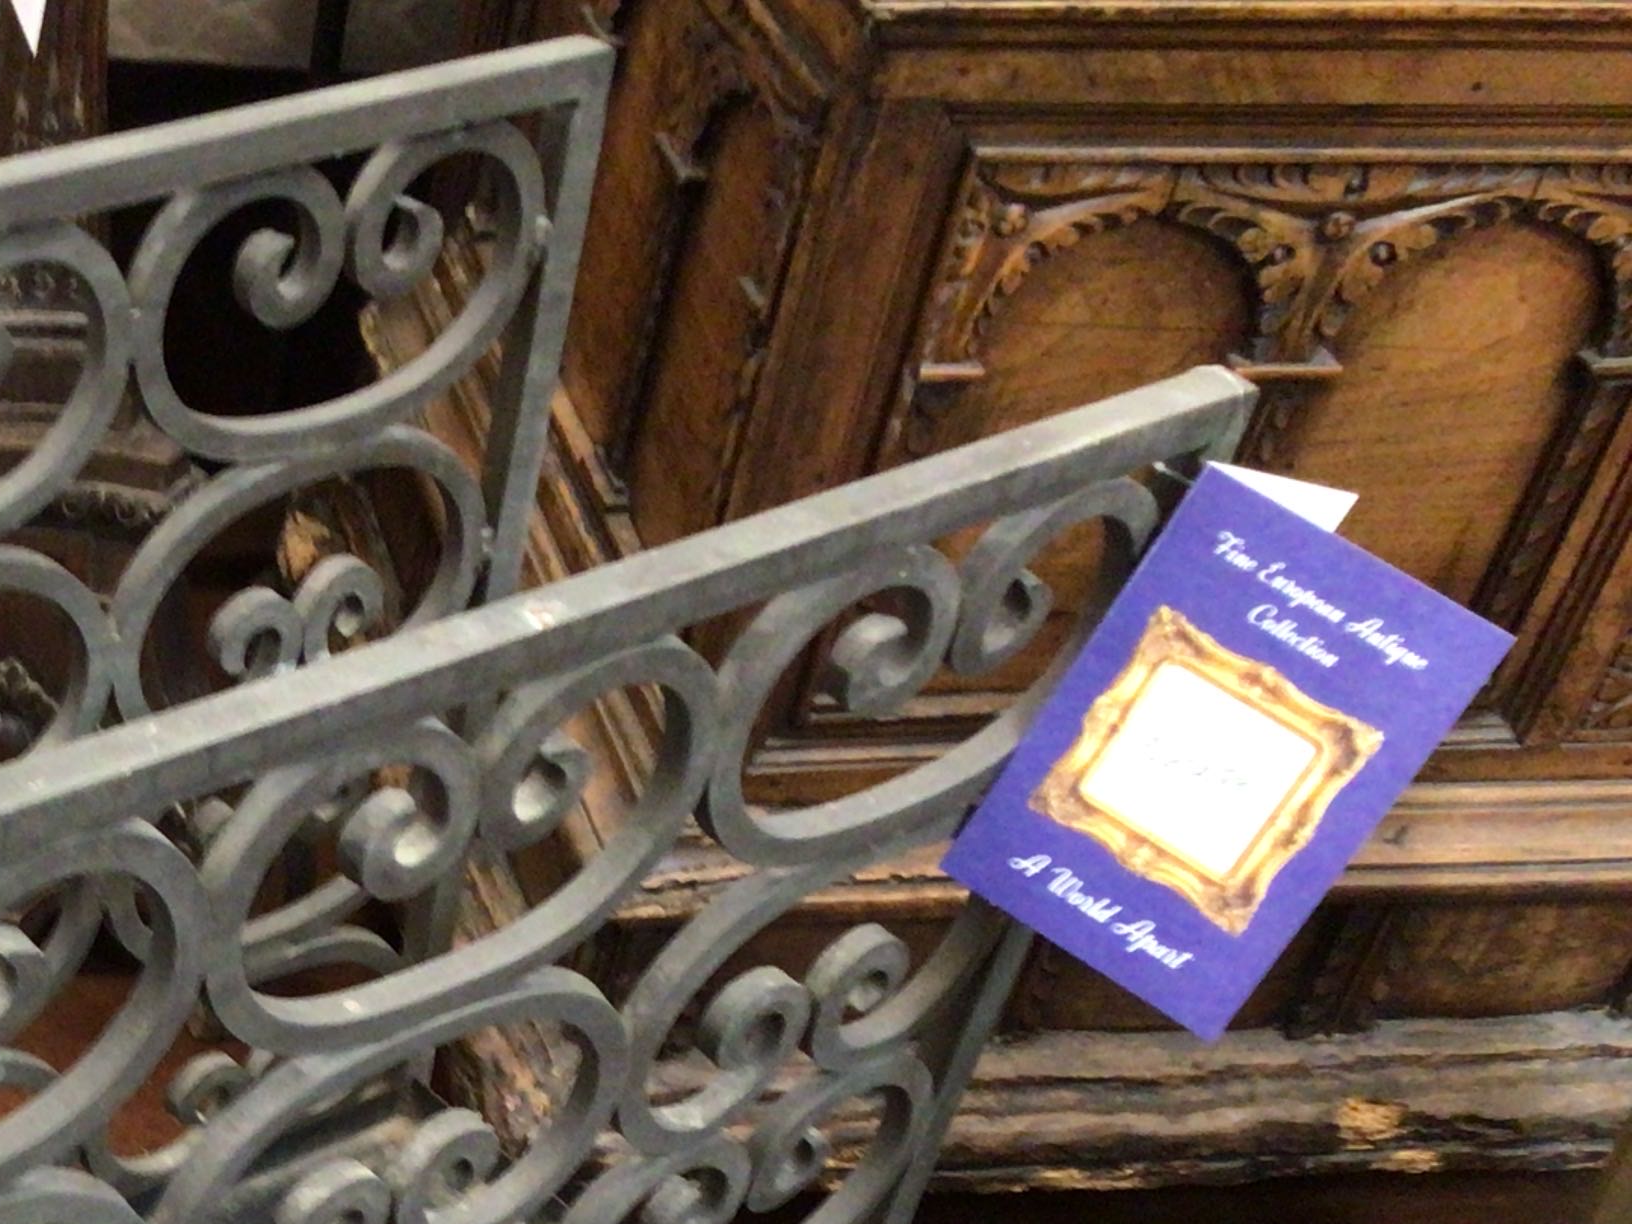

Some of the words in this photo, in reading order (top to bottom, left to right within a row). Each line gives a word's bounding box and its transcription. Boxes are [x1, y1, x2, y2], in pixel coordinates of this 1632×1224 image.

[1213, 530, 1257, 572] Fine
[1257, 562, 1346, 623] European
[1344, 617, 1428, 670] Antique
[1246, 603, 1340, 669] Collection
[1008, 854, 1052, 878] A
[1048, 866, 1123, 923] World
[1111, 919, 1195, 971] Apart
